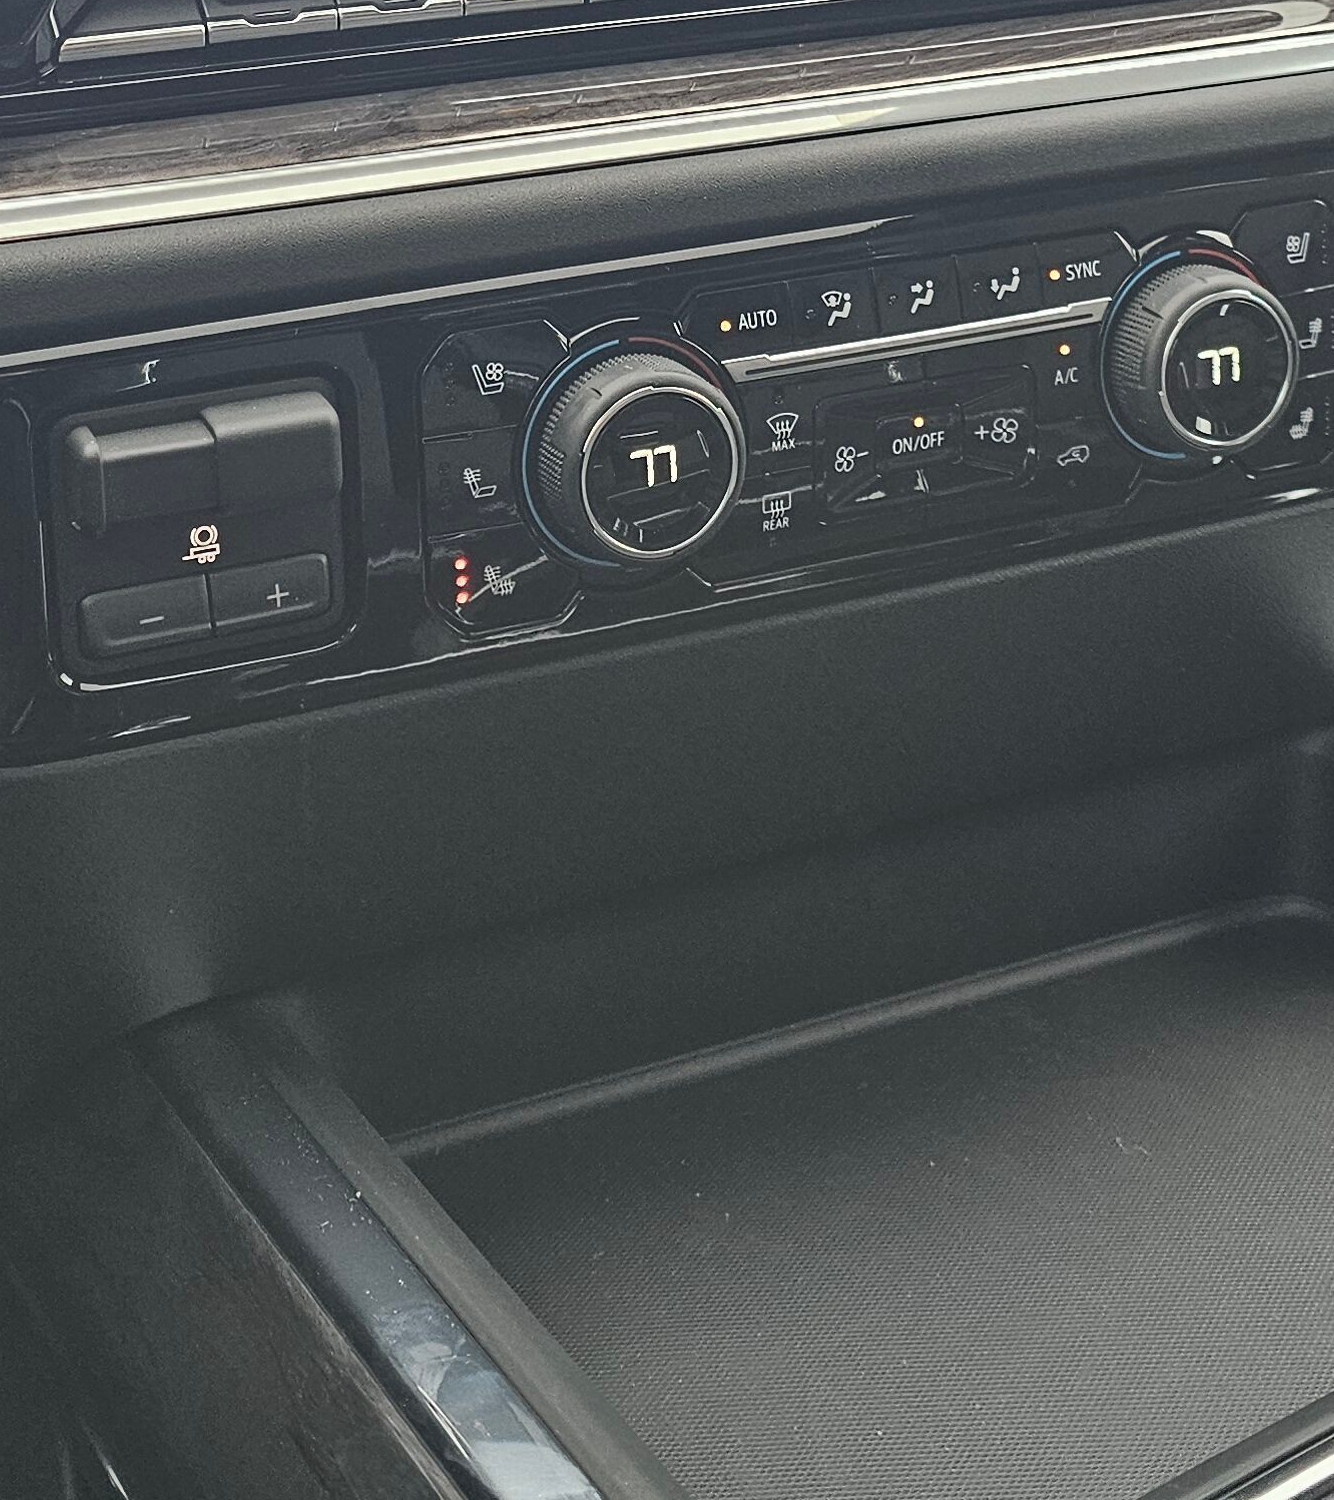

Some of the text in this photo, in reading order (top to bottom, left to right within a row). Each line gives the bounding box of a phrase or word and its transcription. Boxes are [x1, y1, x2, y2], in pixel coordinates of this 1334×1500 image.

[1065, 260, 1102, 281] SYNC
[738, 309, 777, 331] AUTO
[1054, 367, 1079, 386] A/C
[1197, 346, 1241, 386] 77
[771, 437, 796, 452] MAX
[892, 431, 945, 455] ON/OFF
[630, 444, 678, 487] 77
[762, 516, 790, 533] REAR
